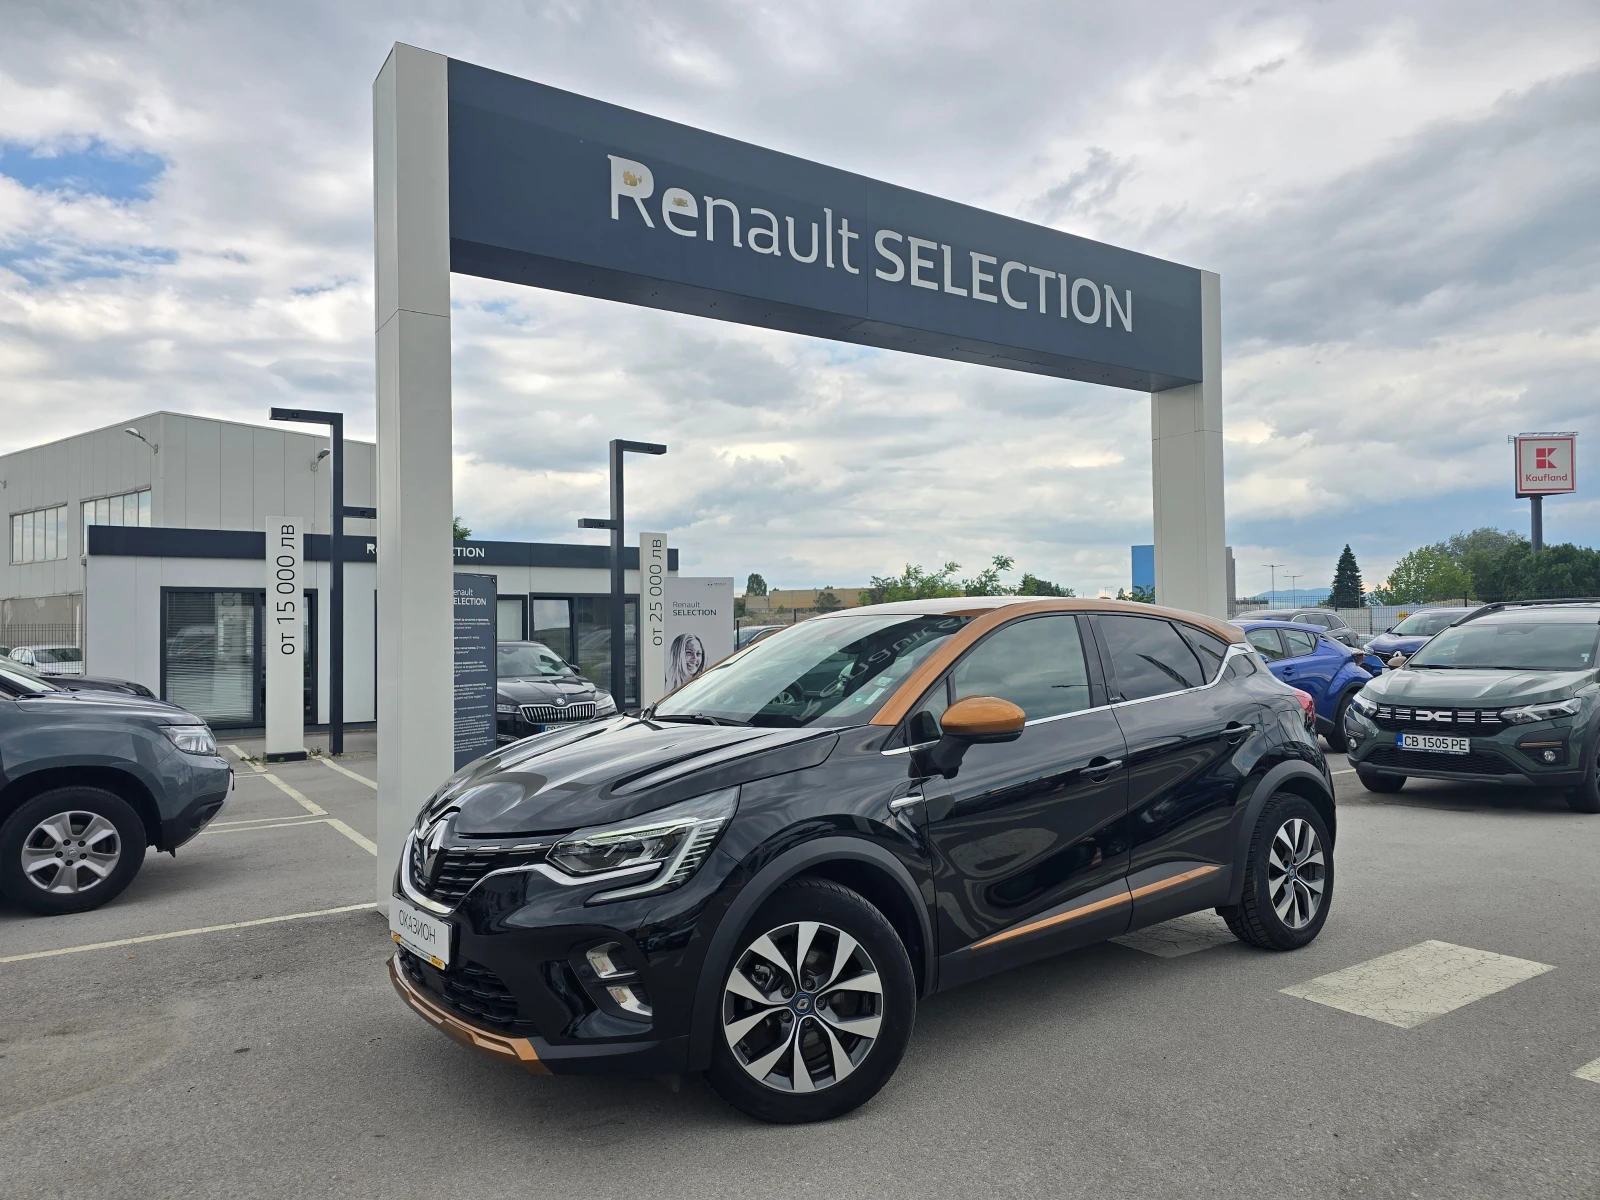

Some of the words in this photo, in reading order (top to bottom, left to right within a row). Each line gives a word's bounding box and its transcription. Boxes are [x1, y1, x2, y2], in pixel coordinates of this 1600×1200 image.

[606, 153, 860, 276] Renault
[873, 229, 1133, 333] SELECTION
[1525, 473, 1568, 482] Kaufland
[276, 555, 295, 594] 000
[649, 564, 662, 597] 000
[453, 588, 473, 597] enault
[453, 597, 487, 606] ELECTION
[276, 602, 295, 625] 15
[649, 602, 663, 622] 25
[672, 600, 701, 609] Renault
[1404, 735, 1419, 747] CB
[1422, 737, 1449, 749] 1505
[1451, 738, 1467, 751] PE
[398, 909, 436, 945] ОКАЗИОН
